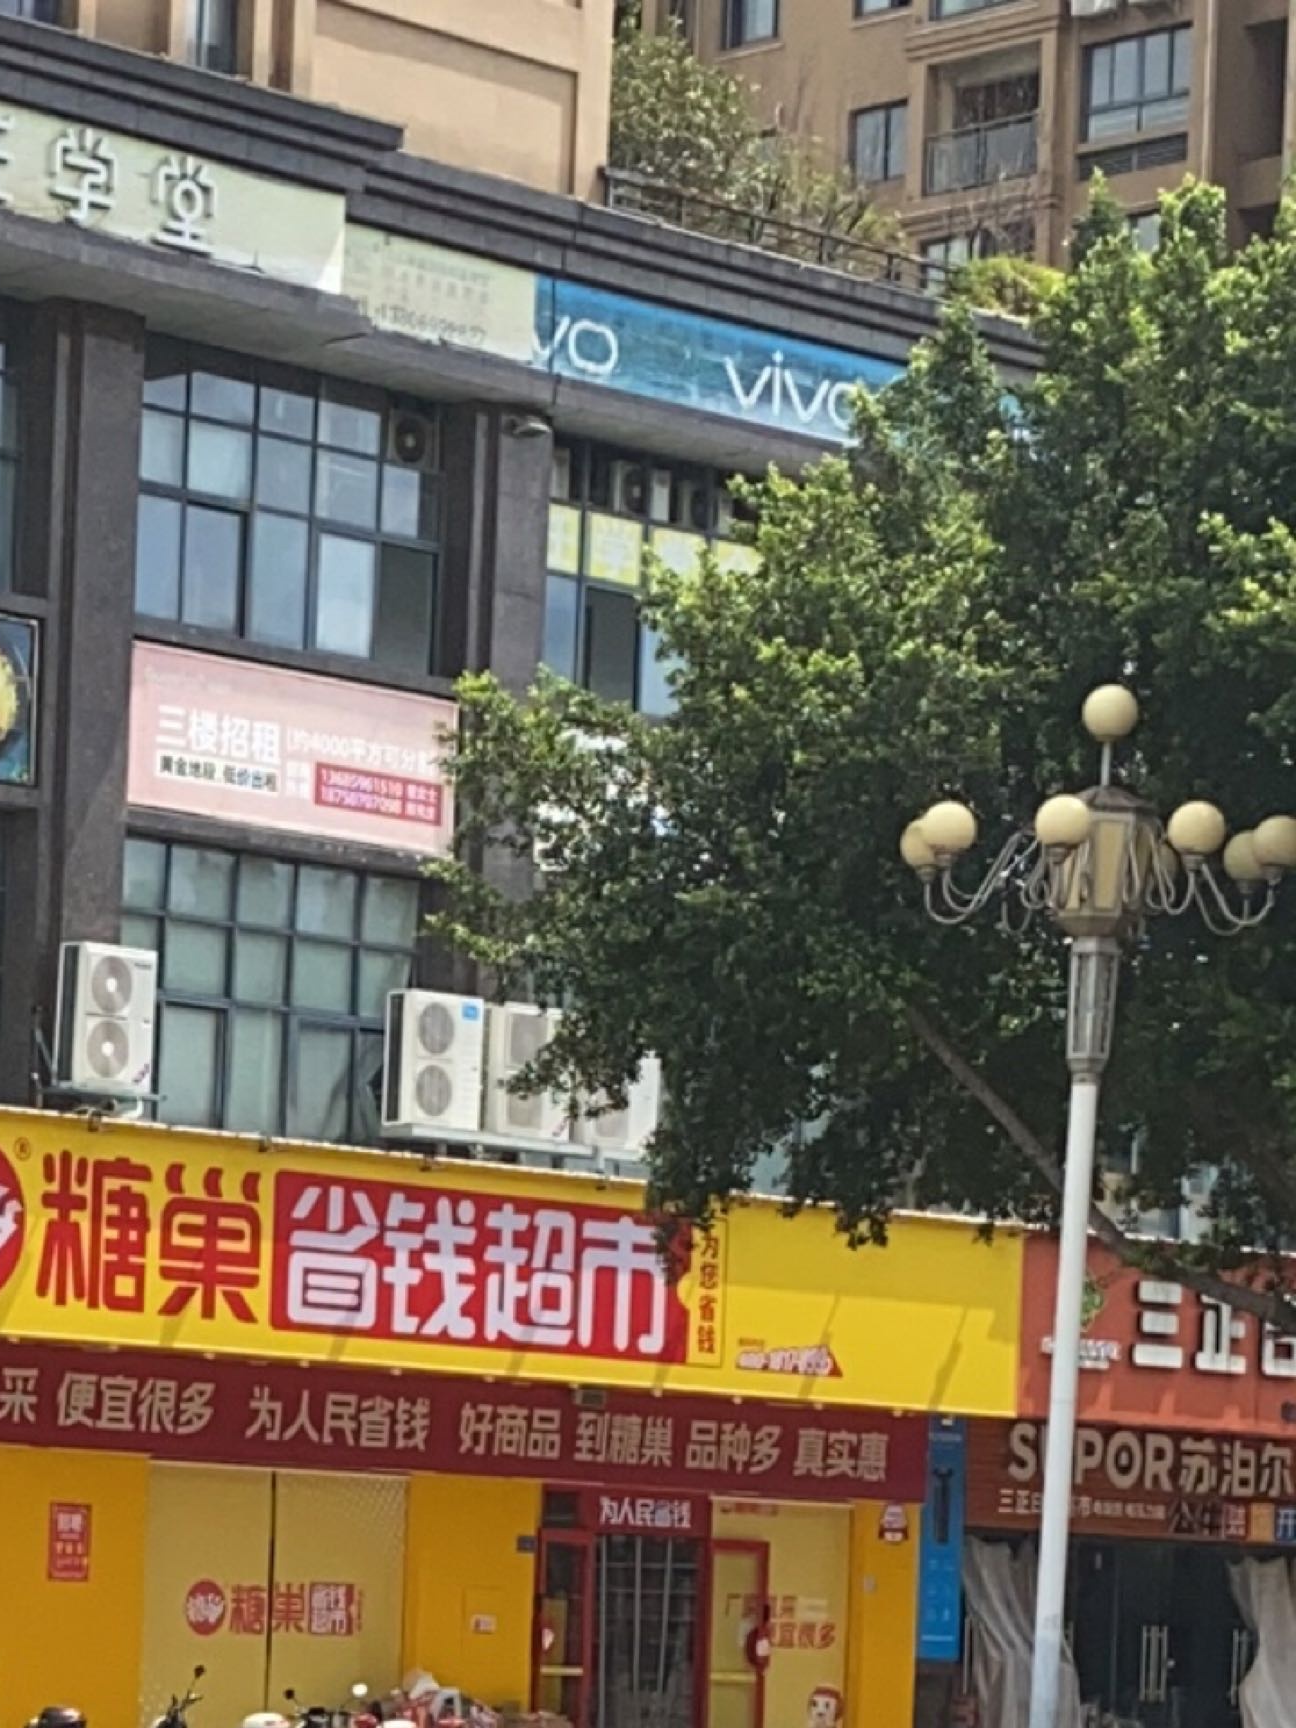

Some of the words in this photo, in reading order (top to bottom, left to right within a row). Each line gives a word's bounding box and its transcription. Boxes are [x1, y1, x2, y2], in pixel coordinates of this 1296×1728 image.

[156, 704, 281, 765] 三楼招租
[35, 1150, 261, 1324] 糖巢
[287, 1185, 666, 1355] 省钱超市
[57, 1371, 216, 1435] 便宜很多
[245, 1385, 431, 1452] 为人民省钱
[458, 1401, 562, 1461] 好商品
[573, 1411, 674, 1468] 到糖巢
[685, 1418, 783, 1475] 品种多
[793, 1427, 890, 1482] 真实惠
[1008, 1423, 1174, 1492] SPOR
[1179, 1436, 1294, 1498] 苏泊尔
[599, 1496, 692, 1529] 为人民省钱
